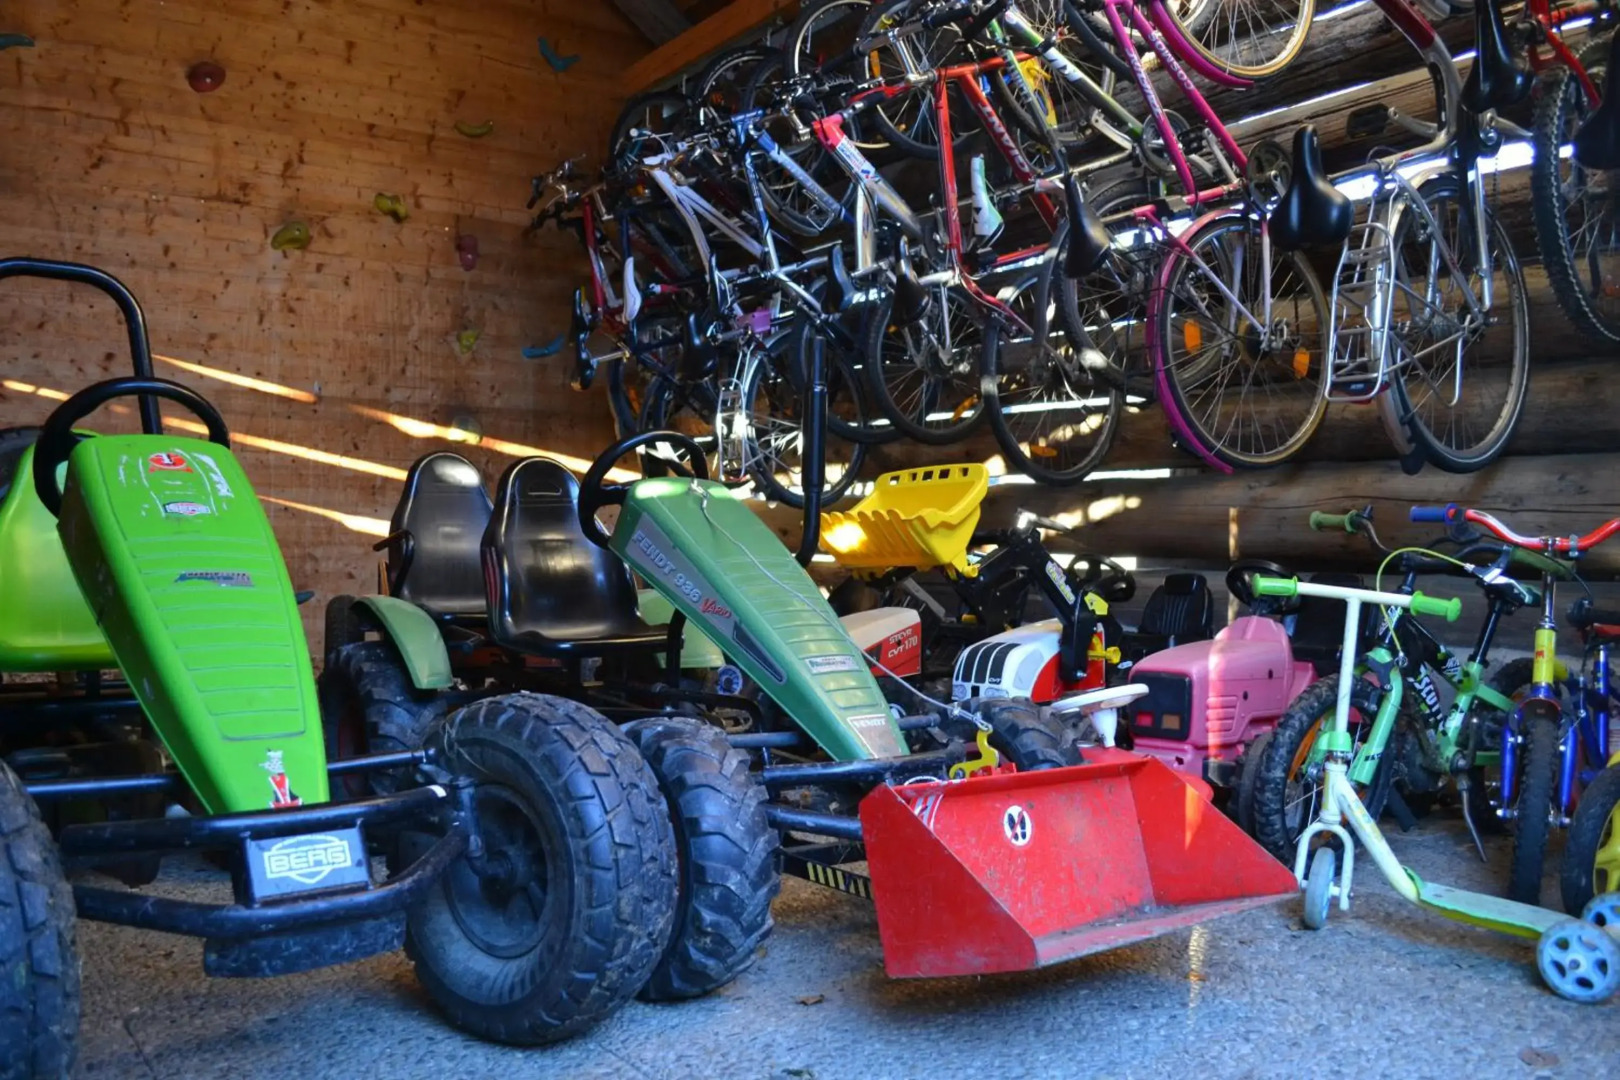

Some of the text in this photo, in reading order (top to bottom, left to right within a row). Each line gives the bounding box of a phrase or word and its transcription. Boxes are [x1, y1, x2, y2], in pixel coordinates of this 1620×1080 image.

[1148, 33, 1195, 90] COSMOS
[978, 103, 1030, 173] GIANT
[632, 529, 676, 575] FENDT
[887, 635, 918, 658] CVT 170
[270, 847, 347, 874] BERG
